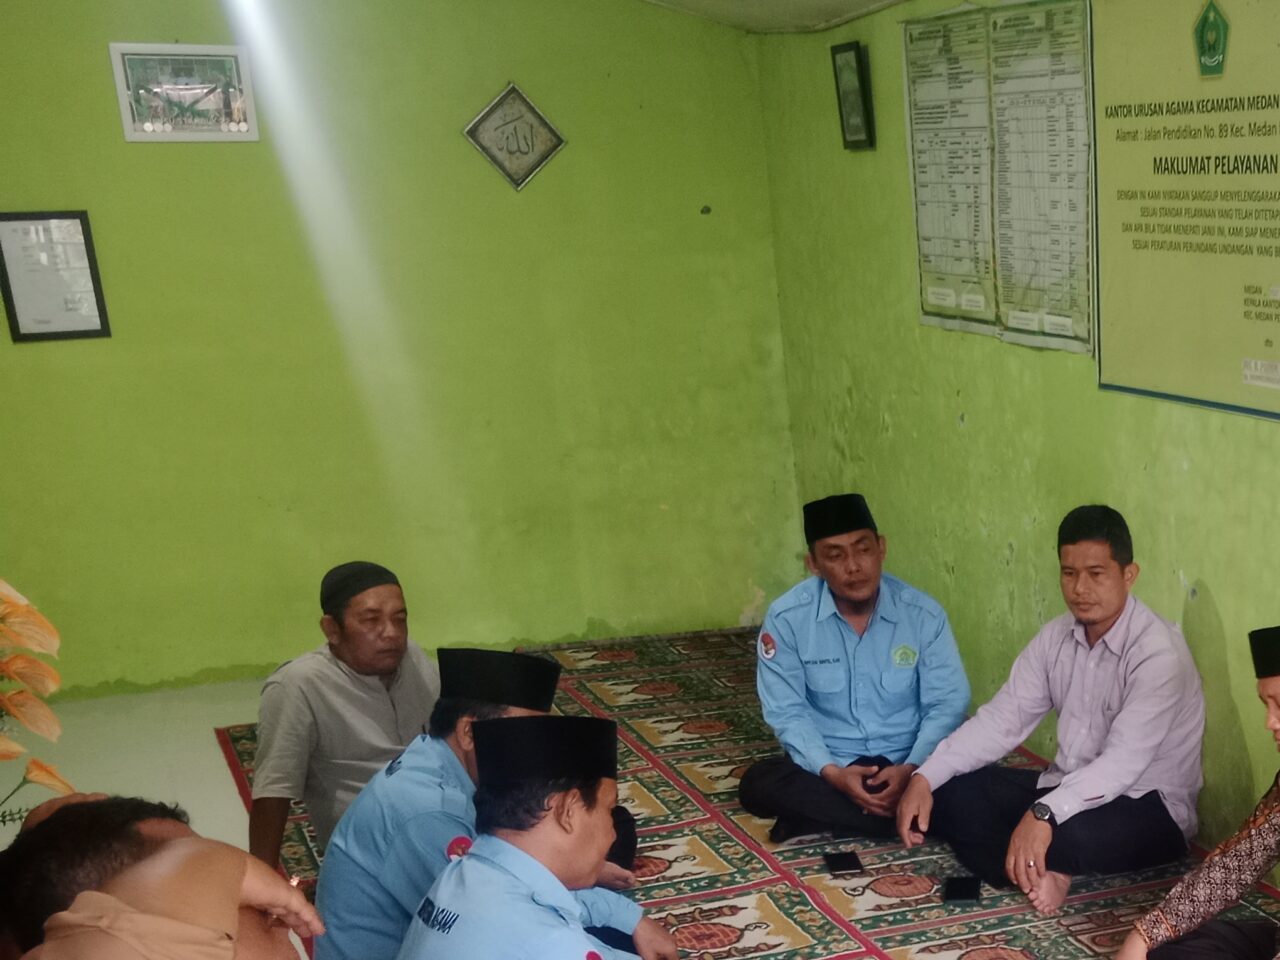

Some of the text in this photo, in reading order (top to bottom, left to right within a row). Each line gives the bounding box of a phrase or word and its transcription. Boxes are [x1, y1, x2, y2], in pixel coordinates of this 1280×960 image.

[1105, 104, 1133, 119] KANTOR
[1134, 103, 1164, 118] URUSAN
[1165, 101, 1194, 116] AGAMA
[1196, 97, 1245, 114] KECAMATAN
[1247, 94, 1280, 111] MEDAN
[1116, 128, 1139, 141] Alamat
[1143, 126, 1161, 141] Jalan
[1162, 124, 1202, 140] Pendidikan
[1203, 124, 1217, 138] No.
[1218, 122, 1229, 138] 89
[1230, 121, 1246, 137] Kec.
[1248, 120, 1277, 137] Medan
[1153, 154, 1279, 175] MAKLUMAT PELAYANAN
[1217, 209, 1234, 220] YANG
[1235, 209, 1253, 220] TELAH
[1228, 227, 1244, 238] KAMI
